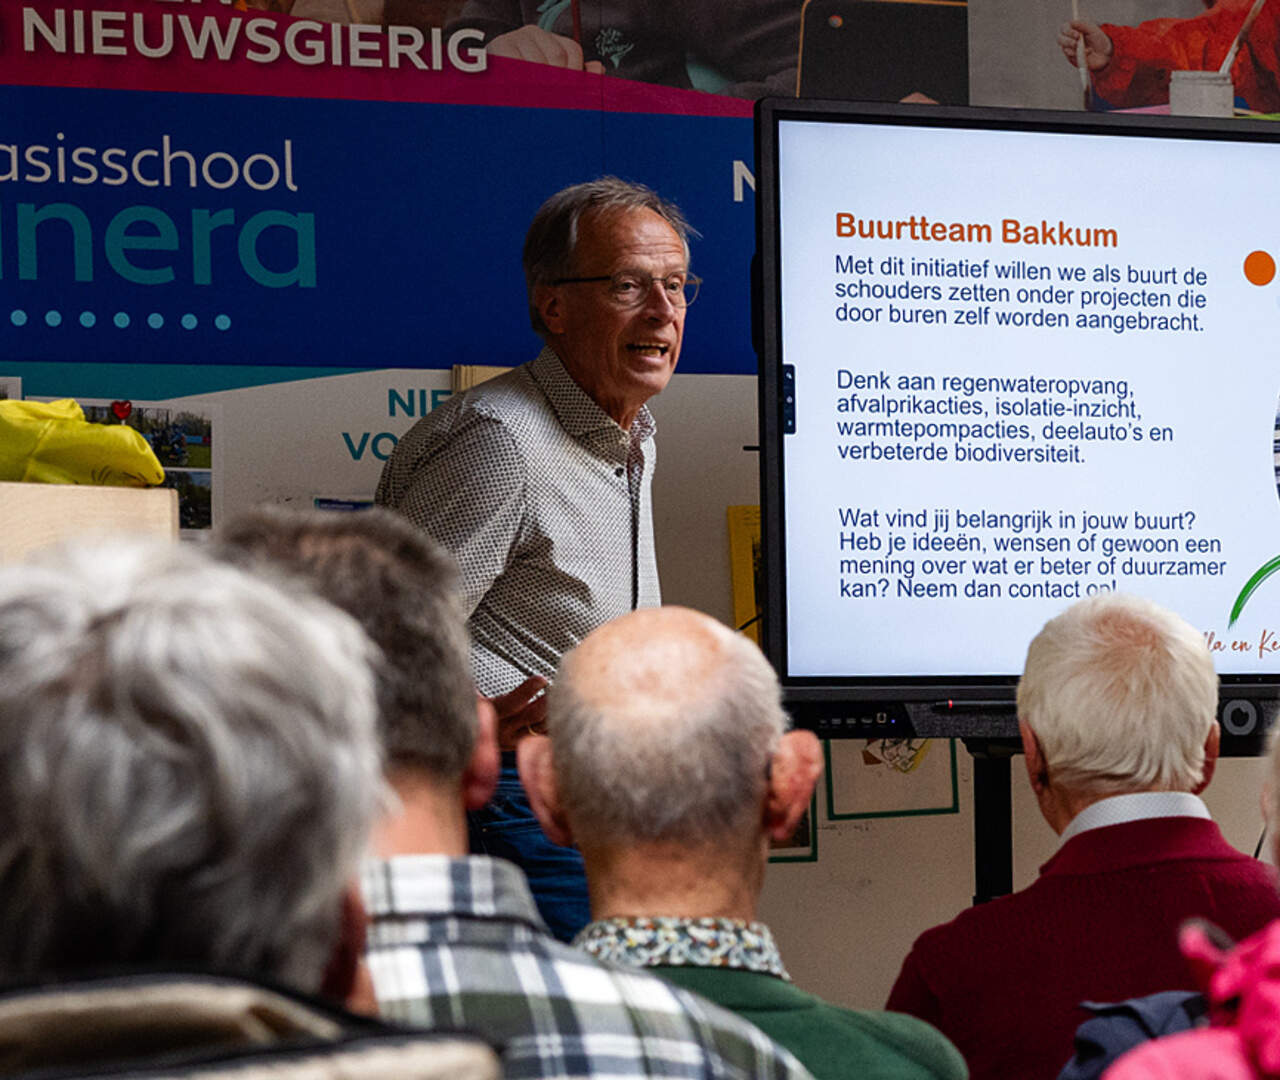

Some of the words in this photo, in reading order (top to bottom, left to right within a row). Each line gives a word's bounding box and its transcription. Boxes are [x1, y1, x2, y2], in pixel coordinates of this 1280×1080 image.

[22, 6, 488, 74] NIEUWSGIERIG
[835, 212, 993, 244] Buurtteam
[1001, 218, 1118, 248] Bakkum
[0, 202, 318, 288] nera
[835, 254, 875, 276] Met
[880, 256, 905, 277] dit
[911, 256, 990, 279] initiatief
[994, 260, 1052, 281] willen
[1057, 266, 1087, 282] we
[1092, 263, 1121, 284] als
[1127, 264, 1178, 285] buurt
[1183, 266, 1208, 287] de
[834, 278, 943, 301] schouders
[947, 283, 1010, 303] zetten
[1016, 284, 1075, 305] onder
[1080, 286, 1171, 311] projecten
[1177, 289, 1207, 309] die
[835, 302, 884, 323] door
[888, 303, 947, 325] buren
[953, 305, 991, 326] zelf
[995, 308, 1070, 328] worden
[1075, 310, 1204, 335] aangebracht.
[837, 369, 891, 390] Denk
[897, 375, 936, 391] aan
[942, 374, 1135, 400] regenwateropvang,
[836, 393, 989, 419] afvalprikacties,
[995, 398, 1142, 421] isolatie-inzicht,
[836, 418, 1036, 443] warmtepompacties,
[1149, 426, 1174, 442] en
[837, 440, 949, 462] verbeterde
[954, 442, 1085, 464] biodiversiteit.
[838, 507, 880, 528] Wat
[885, 508, 928, 529] vind
[932, 508, 950, 534] jij
[955, 508, 1053, 534] belangrijk
[1059, 510, 1076, 529] in
[1080, 510, 1129, 535] jouw
[1134, 510, 1196, 531] buurt?
[839, 531, 882, 551] Heb
[884, 531, 907, 558] je
[912, 531, 987, 554] ideeën,
[993, 536, 1071, 553] wensen
[1076, 532, 1097, 553] of
[1101, 537, 1179, 558] gewoon
[1184, 538, 1222, 554] een
[839, 555, 916, 580] mening
[921, 559, 967, 575] over
[971, 557, 1009, 575] wat
[1013, 559, 1035, 576] er
[1040, 556, 1092, 576] beter
[1097, 555, 1117, 576] of
[1121, 556, 1227, 576] duurzamer
[839, 577, 890, 599] kan?
[896, 578, 958, 599] Neem
[963, 578, 1002, 599] dan
[1008, 579, 1081, 599] contact
[1231, 639, 1253, 653] en
